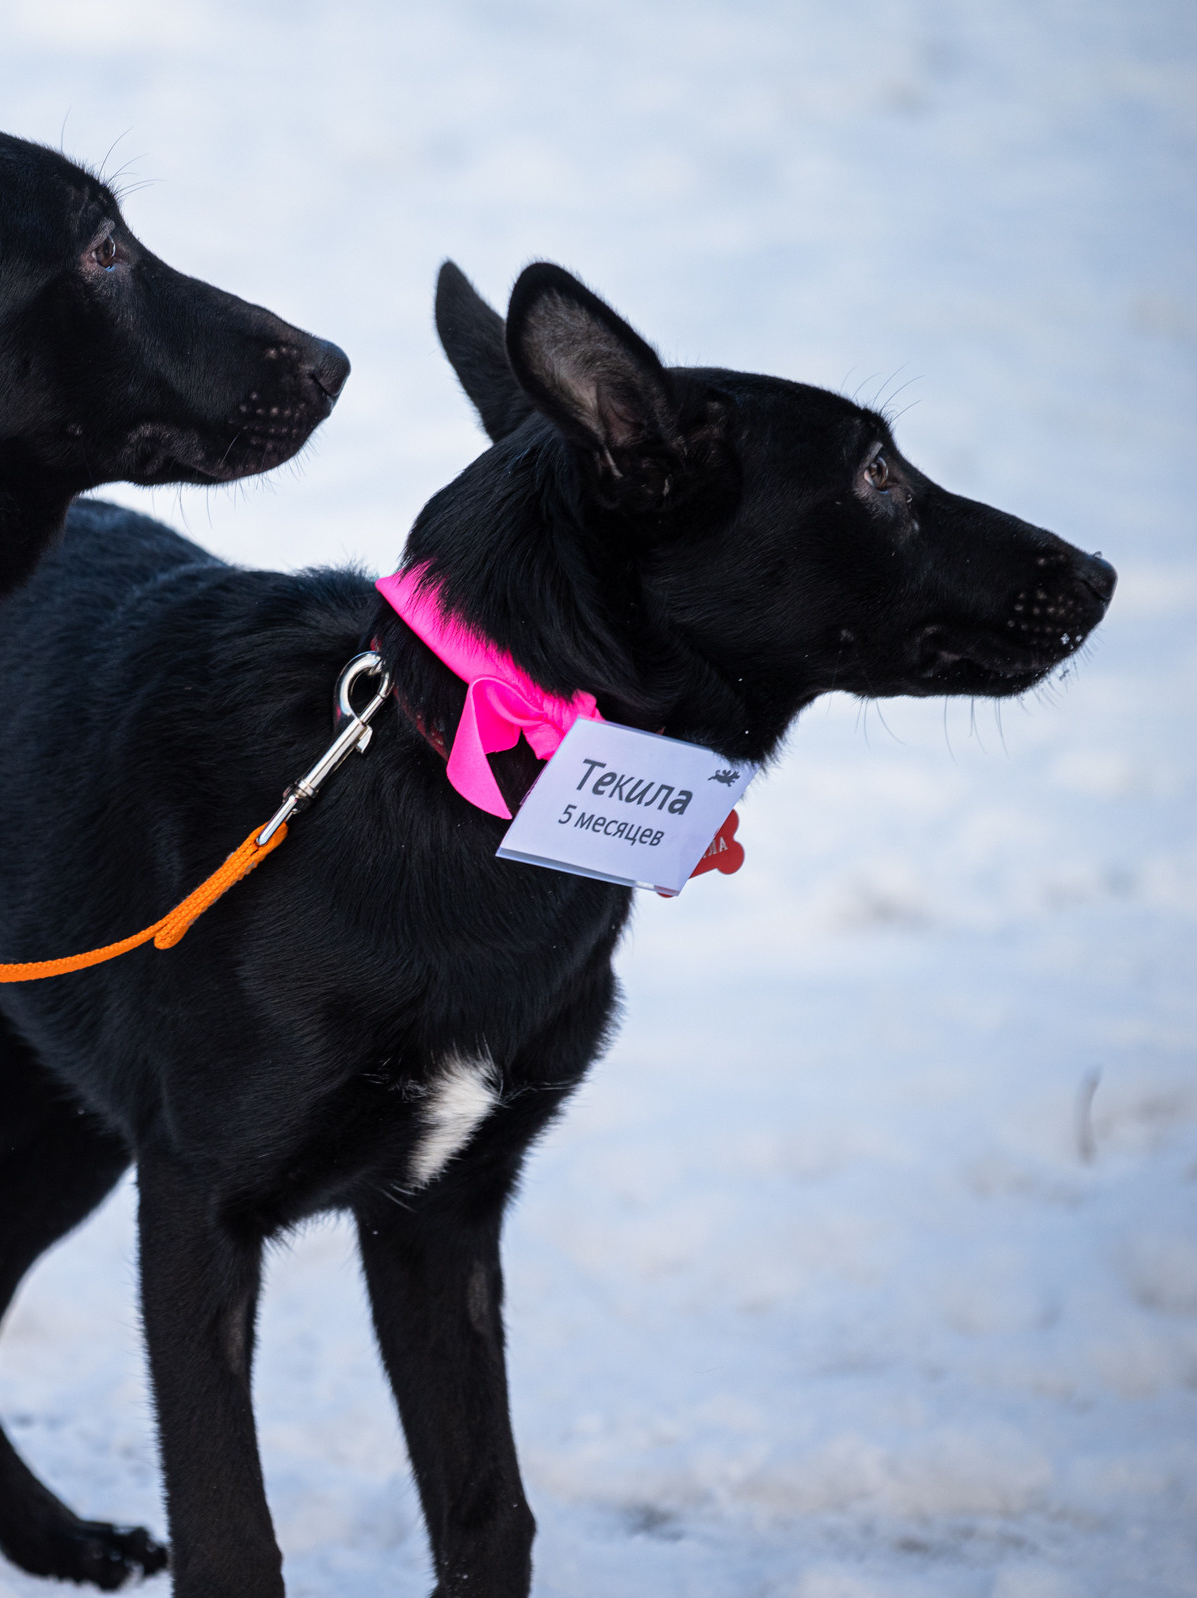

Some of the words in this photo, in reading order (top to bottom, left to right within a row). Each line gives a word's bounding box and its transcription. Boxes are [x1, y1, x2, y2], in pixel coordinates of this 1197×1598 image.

[576, 758, 693, 815] Текила
[558, 804, 577, 824] 5
[574, 811, 665, 847] месяцев
